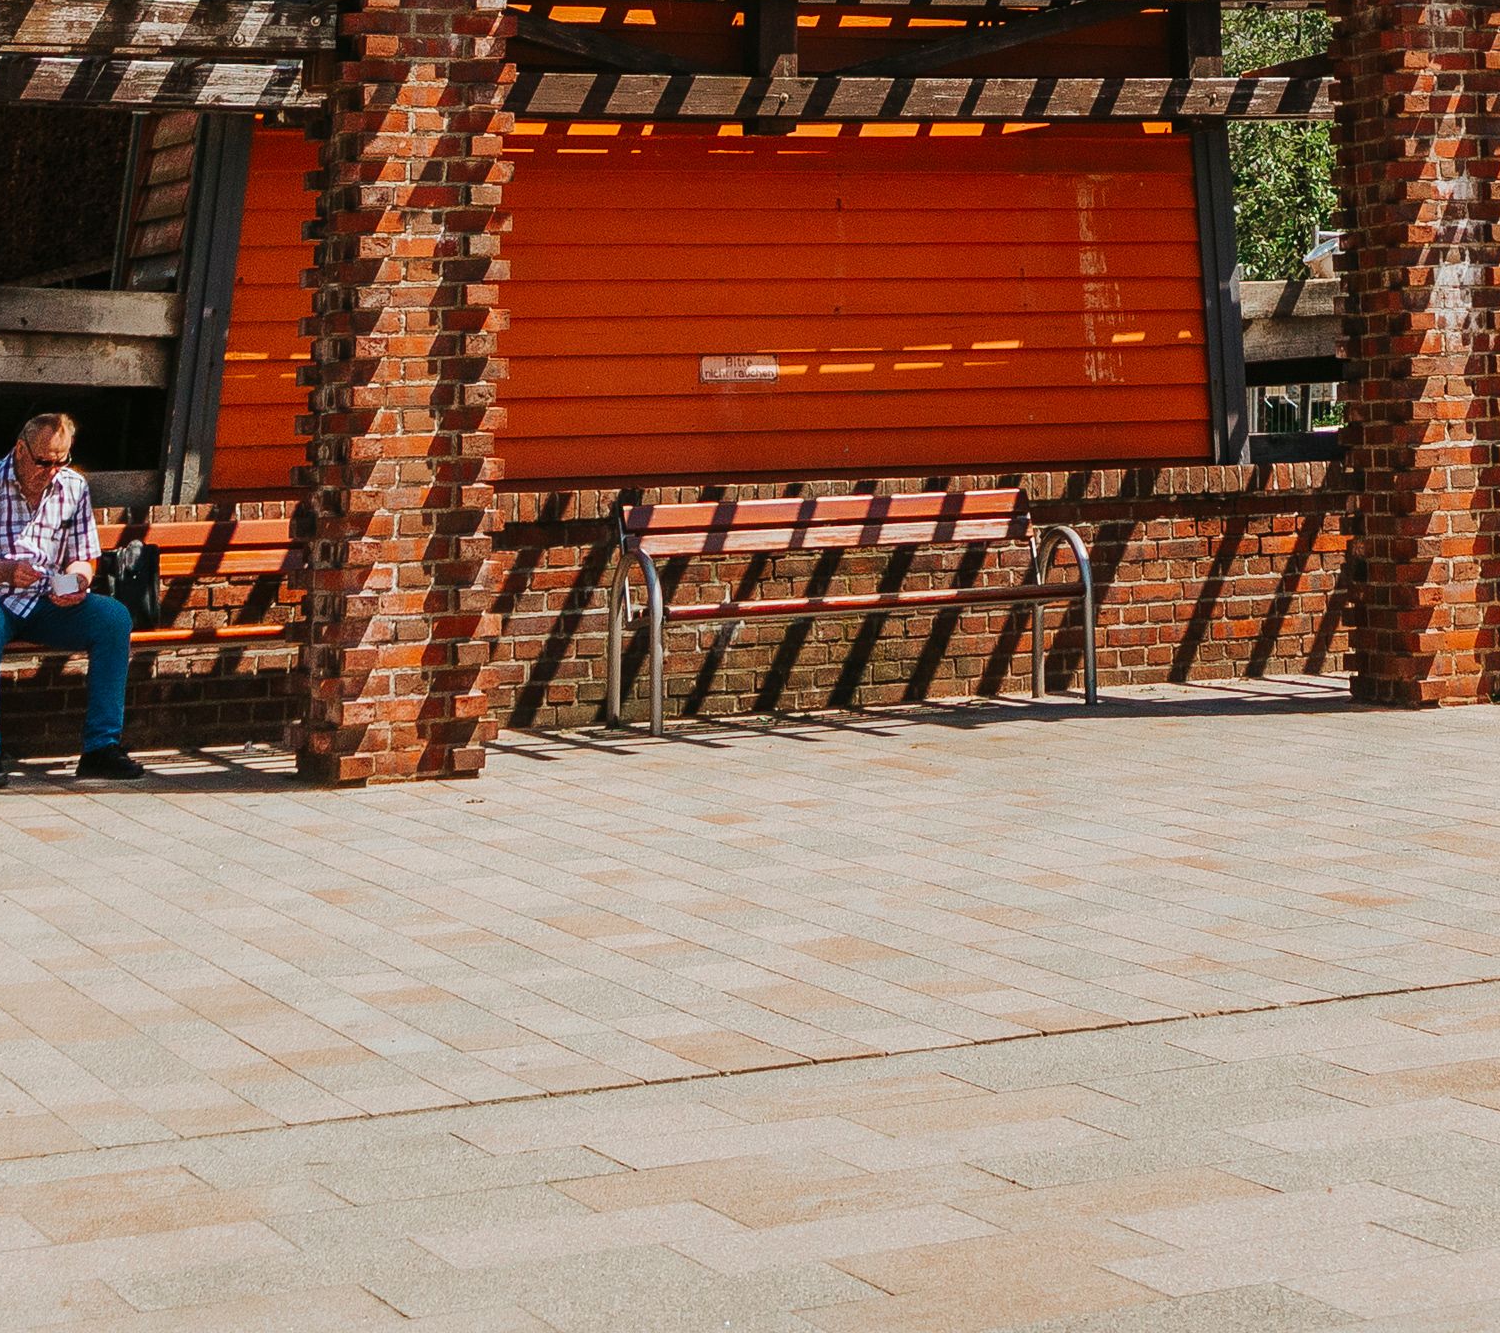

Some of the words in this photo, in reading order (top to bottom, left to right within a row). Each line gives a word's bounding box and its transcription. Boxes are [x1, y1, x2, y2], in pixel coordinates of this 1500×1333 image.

[725, 356, 753, 367] Bitte
[705, 369, 731, 378] nicht
[733, 368, 775, 378] rauchen
